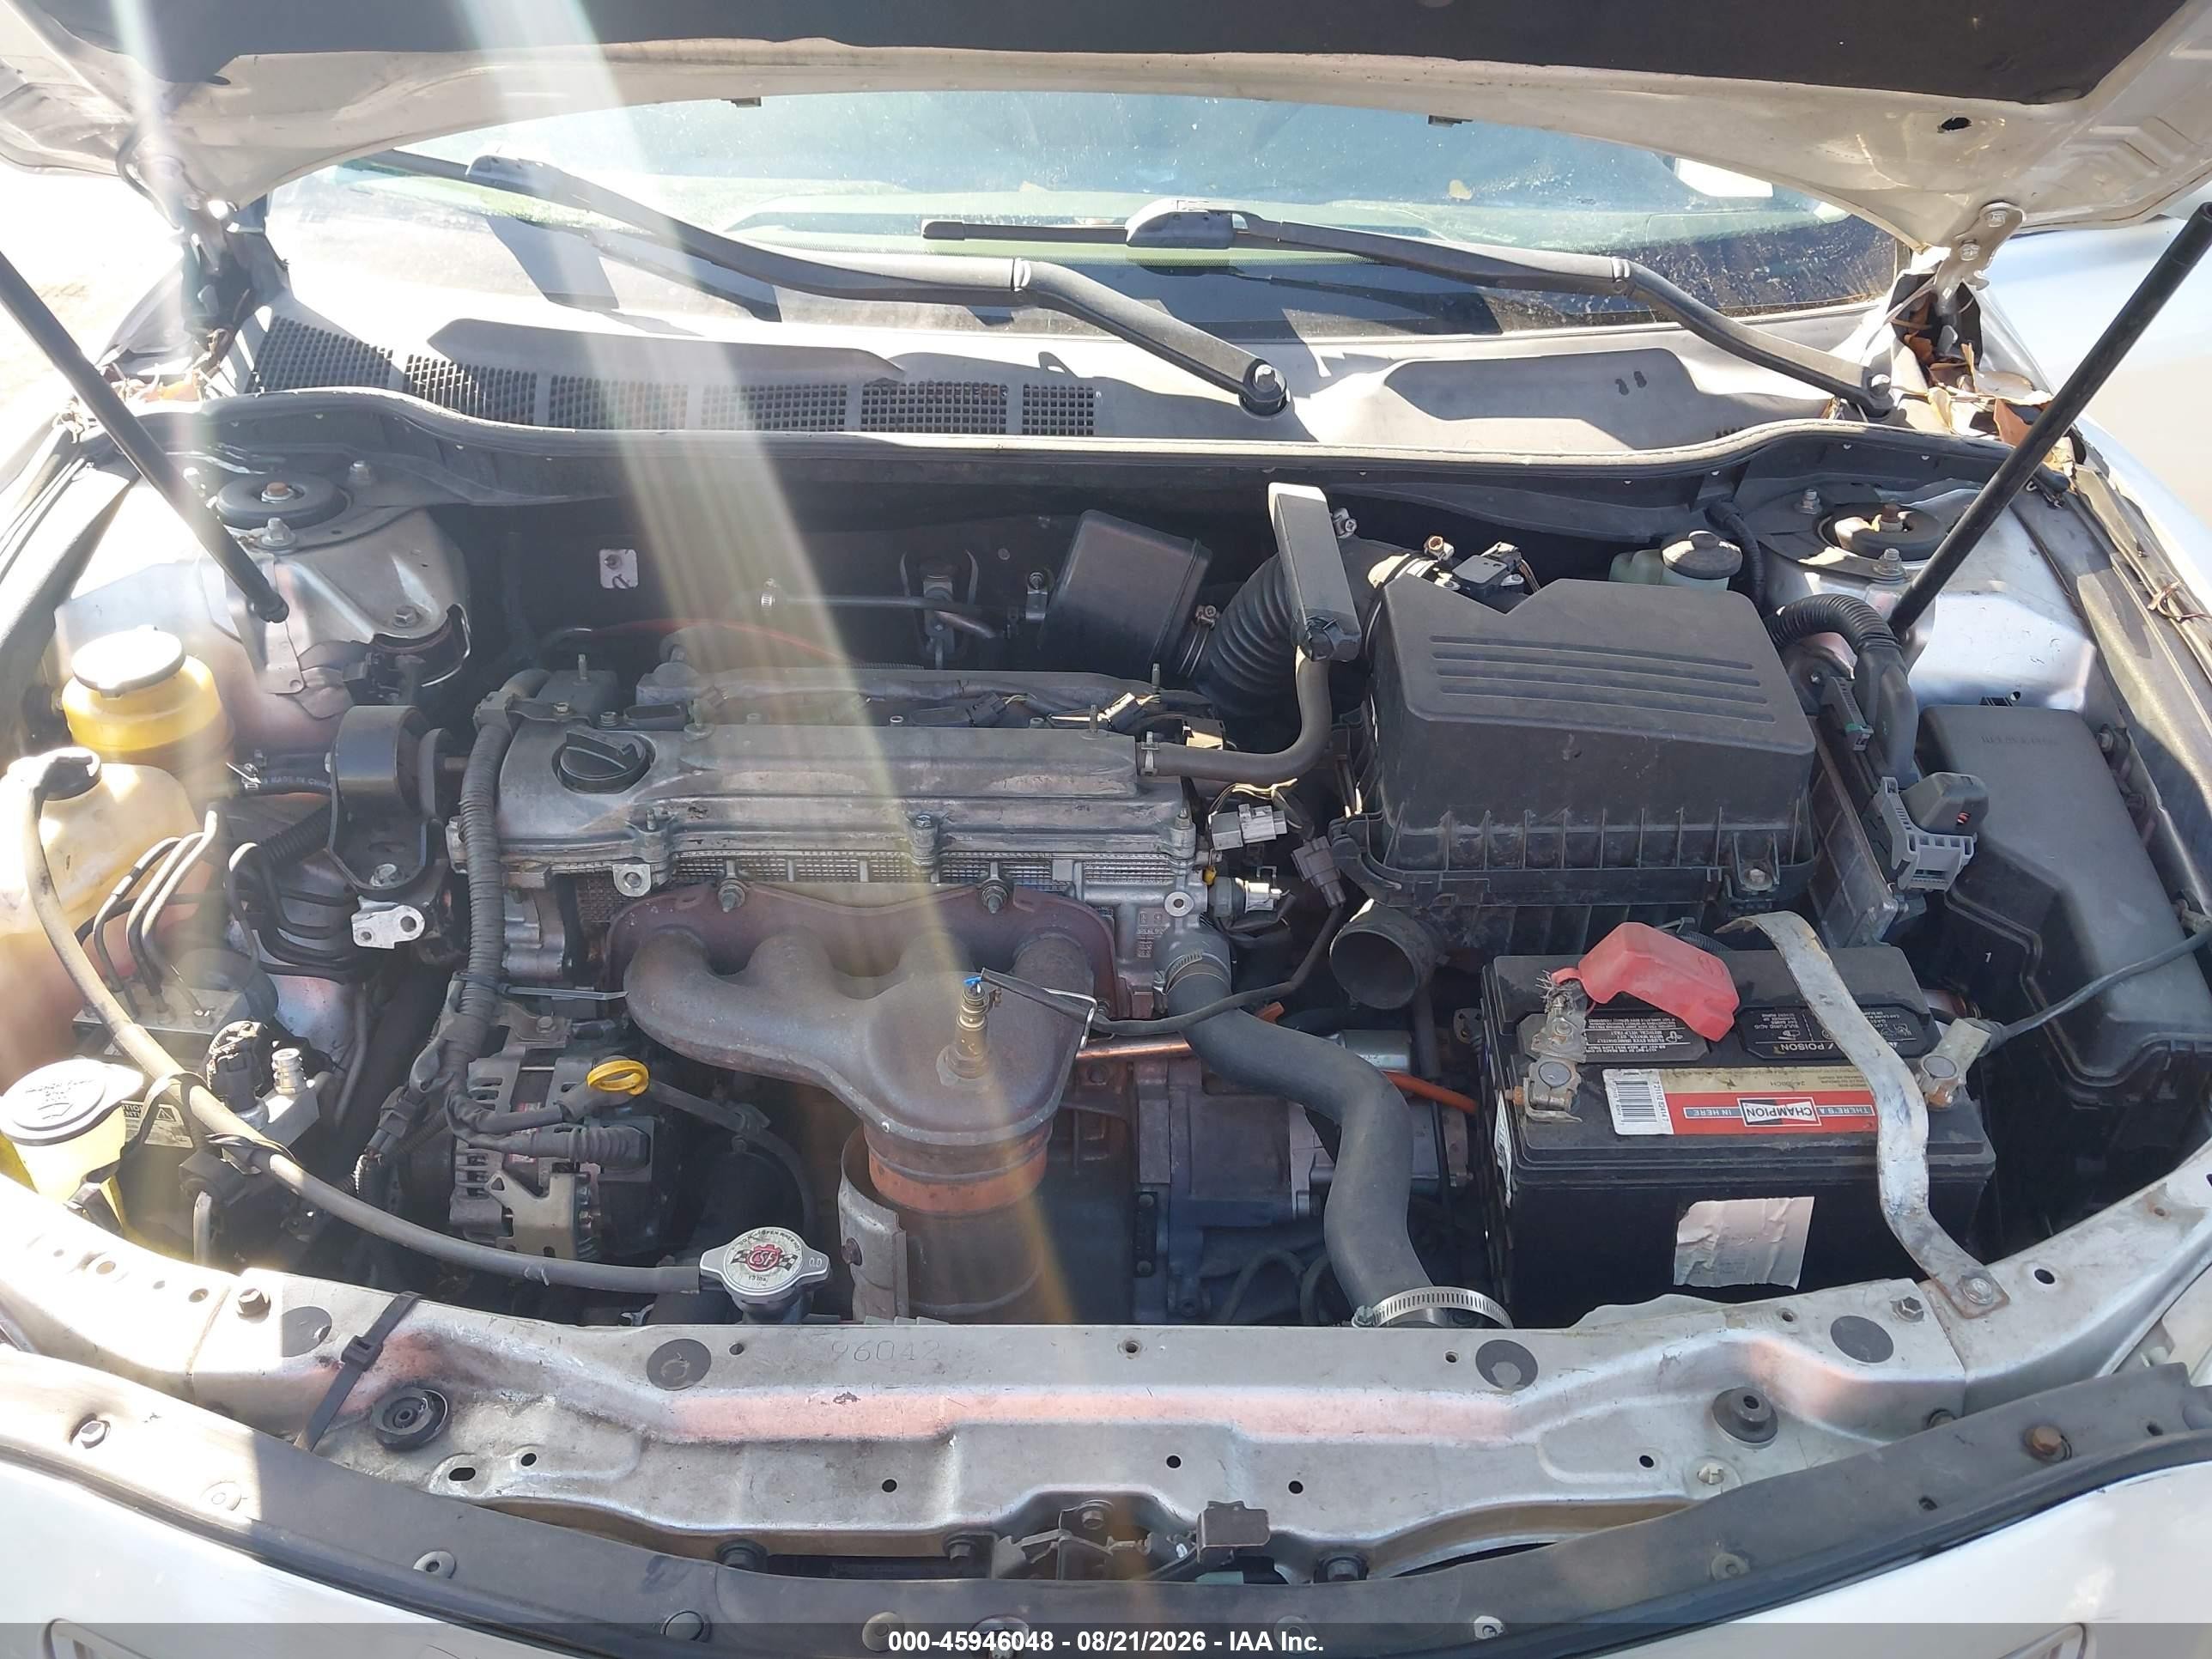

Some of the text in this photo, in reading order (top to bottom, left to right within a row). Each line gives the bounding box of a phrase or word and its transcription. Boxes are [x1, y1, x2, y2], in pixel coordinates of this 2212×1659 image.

[1692, 1108, 1719, 1116] HERE
[1746, 1106, 1813, 1118] CHAMPION
[749, 1251, 776, 1265] CSF
[831, 1339, 940, 1362] 96042
